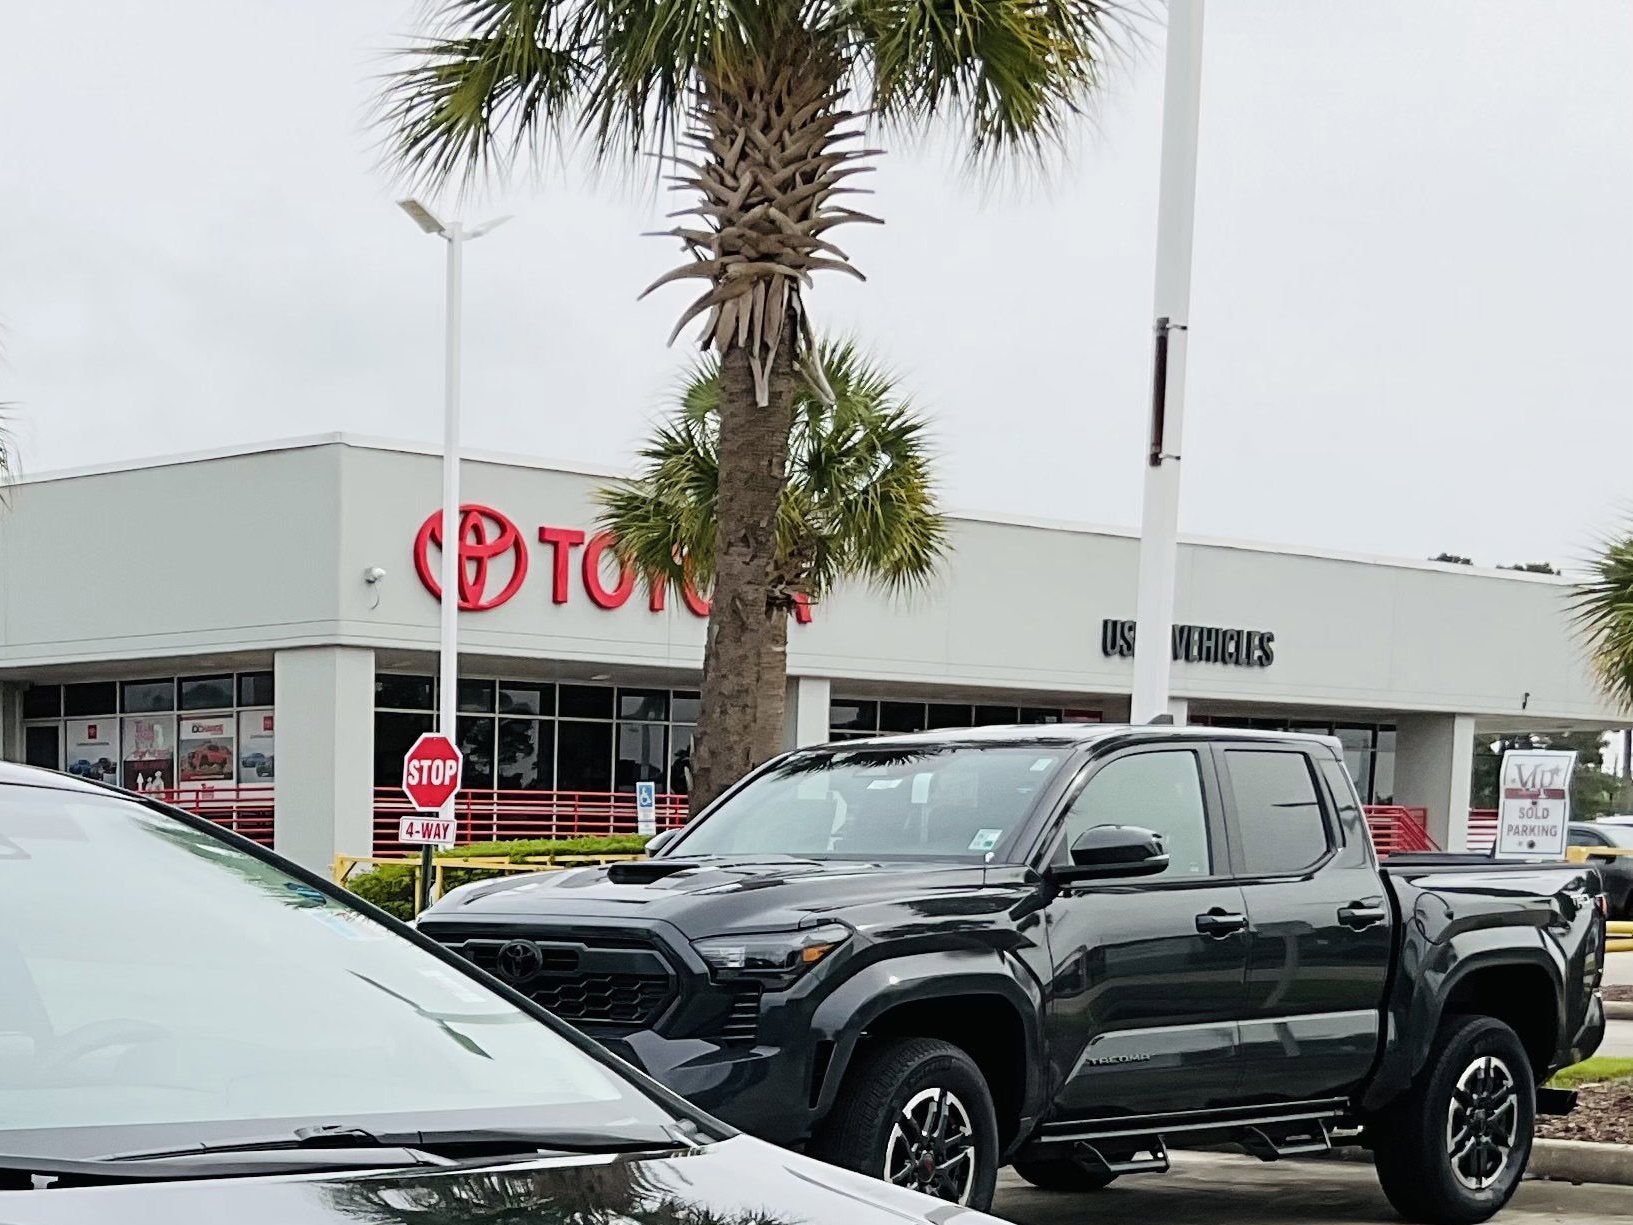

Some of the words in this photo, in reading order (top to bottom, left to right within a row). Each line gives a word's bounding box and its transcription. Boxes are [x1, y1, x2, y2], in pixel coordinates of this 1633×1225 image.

[1101, 618, 1137, 659] US
[1171, 624, 1275, 668] VEHICLES
[407, 758, 457, 786] STOP
[1518, 806, 1550, 820] SOLD
[405, 821, 450, 840] 4-WAY
[1506, 823, 1559, 838] PARKING
[1088, 1052, 1152, 1067] TACOMA
